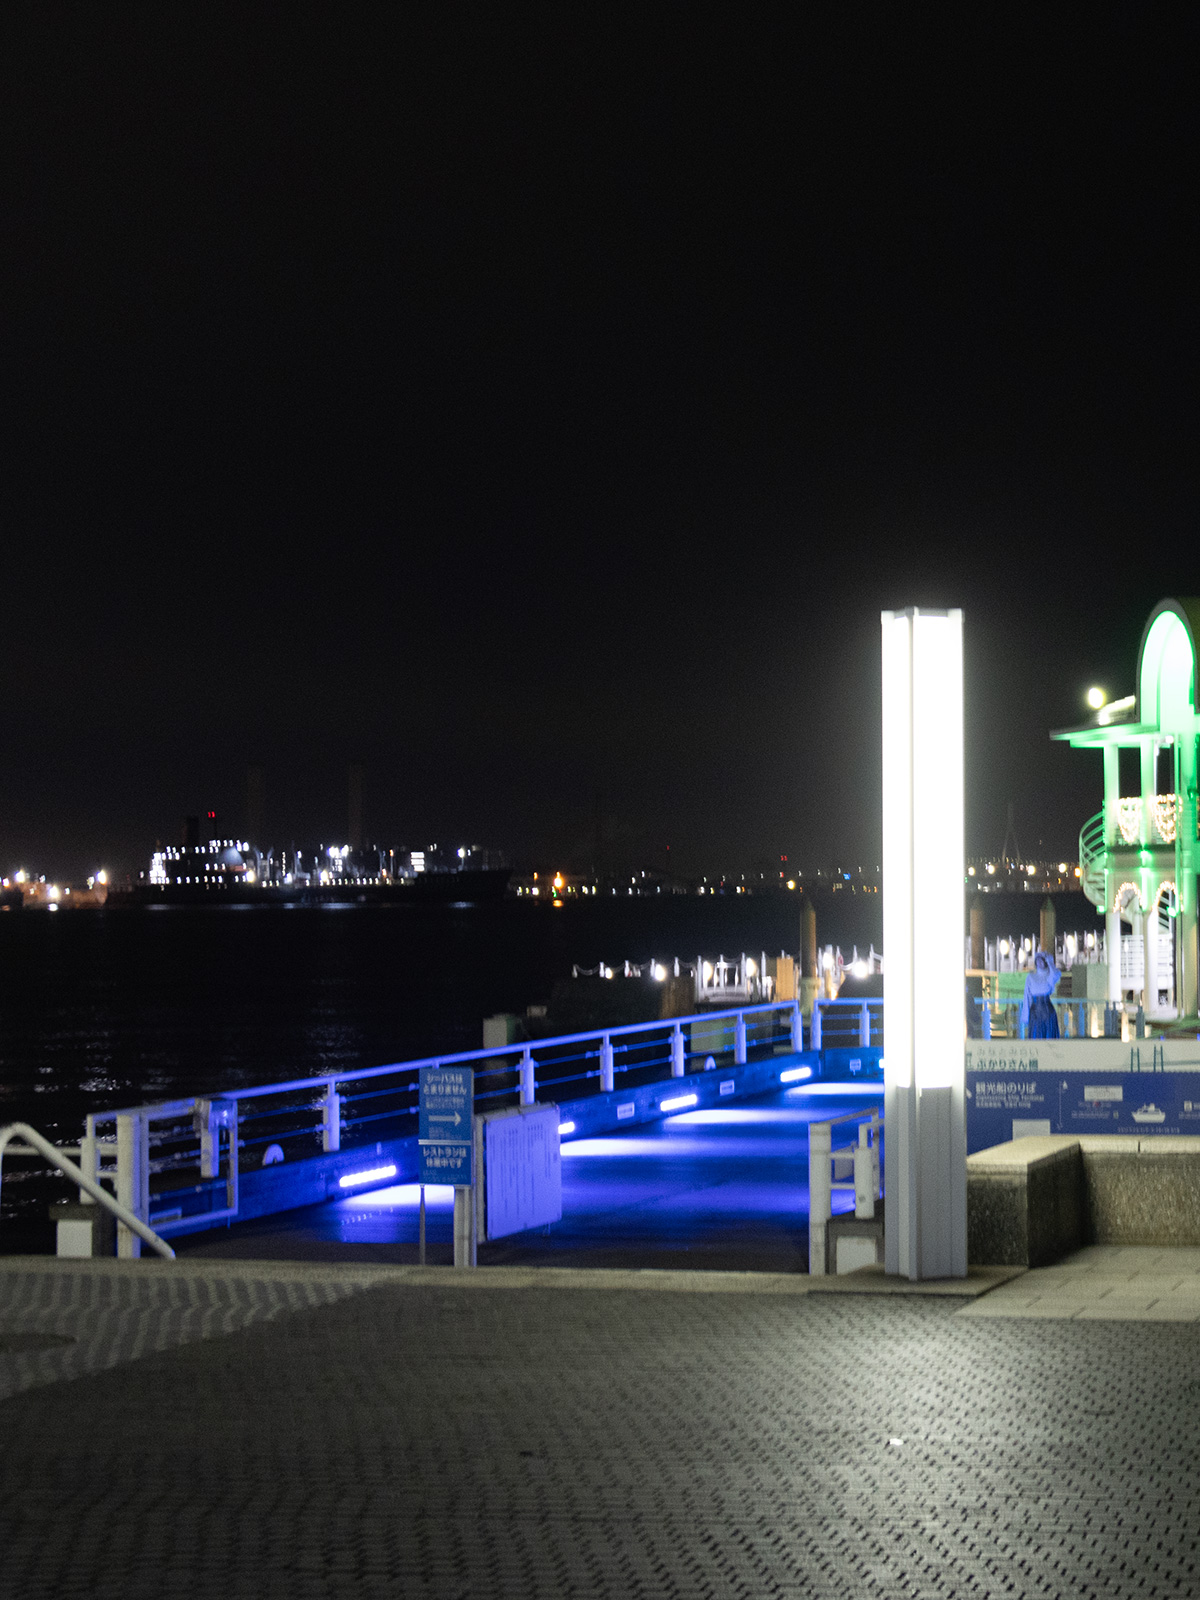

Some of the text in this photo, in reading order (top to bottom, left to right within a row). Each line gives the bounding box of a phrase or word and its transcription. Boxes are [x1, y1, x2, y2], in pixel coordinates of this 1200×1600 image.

[423, 1147, 467, 1158] レストランは
